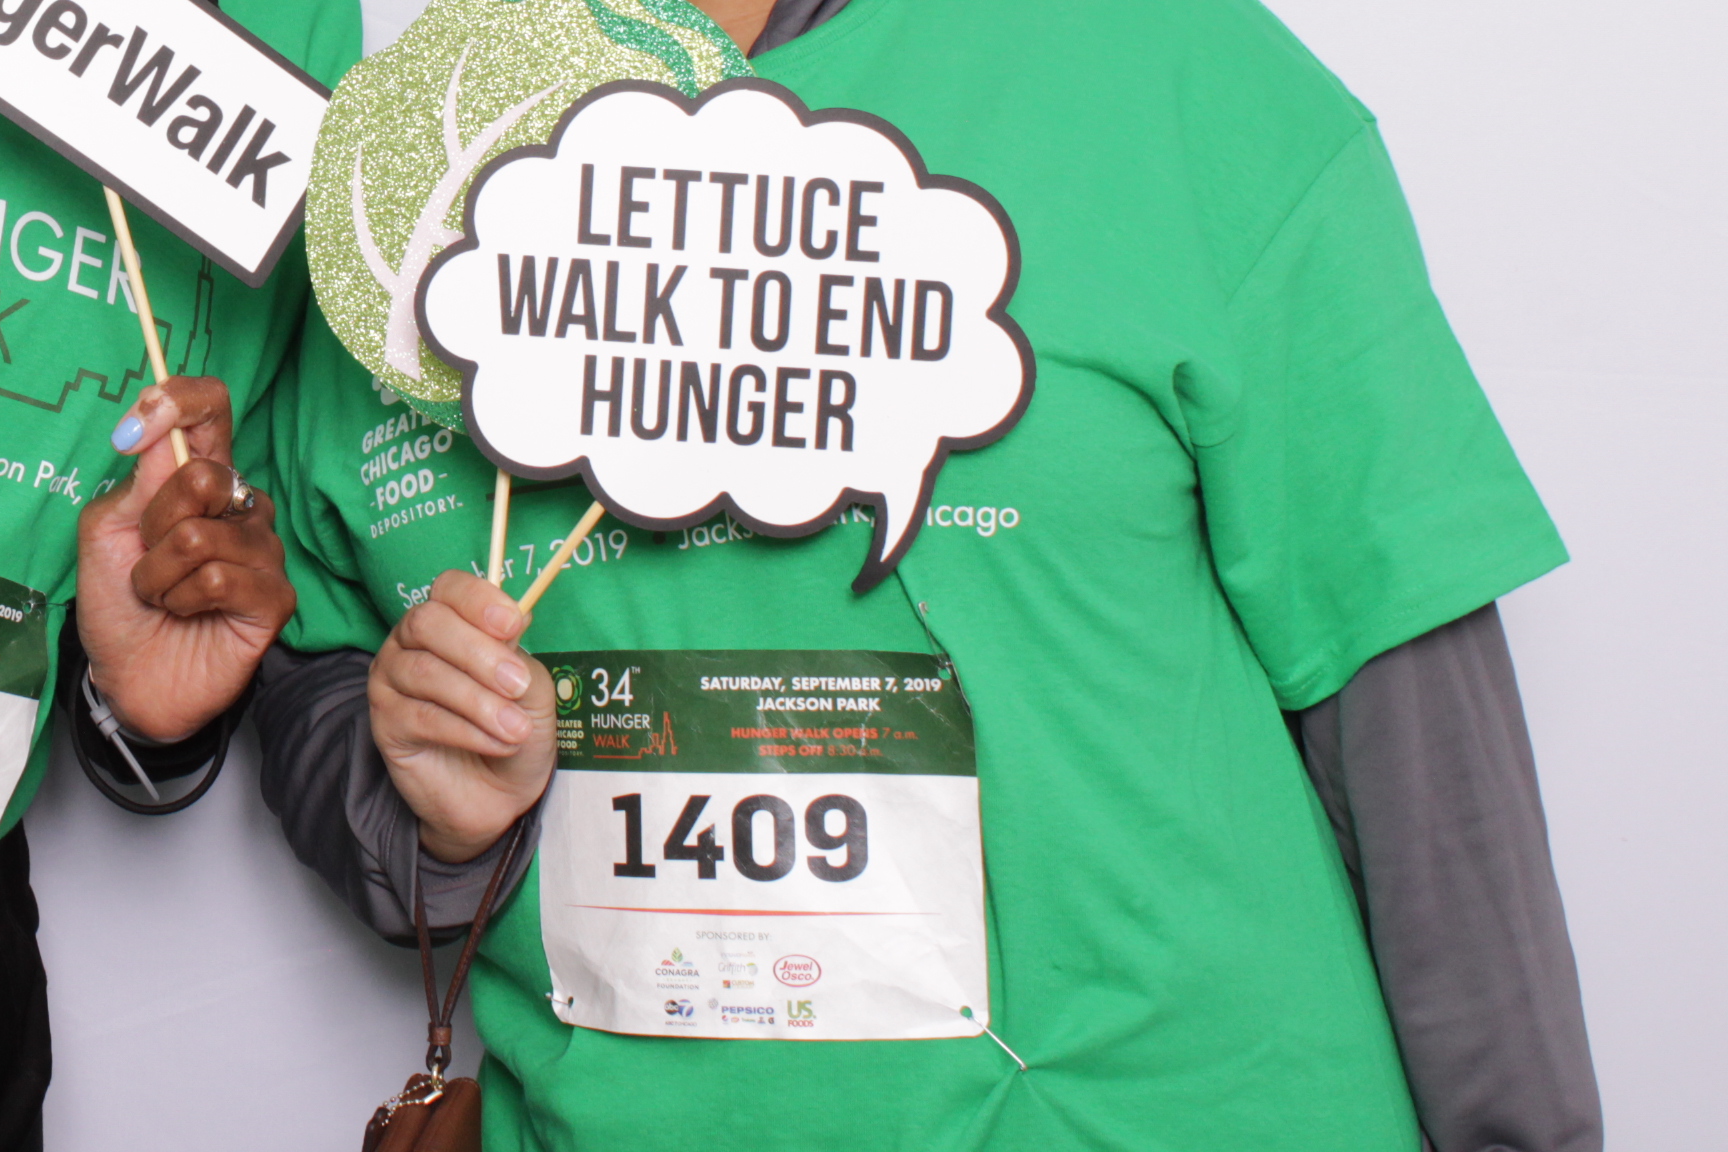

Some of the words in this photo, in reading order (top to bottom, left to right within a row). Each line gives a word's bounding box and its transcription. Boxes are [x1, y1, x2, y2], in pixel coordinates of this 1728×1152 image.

[576, 163, 885, 263] LETTUCE
[497, 252, 688, 347] WALK
[709, 267, 793, 353] TO
[814, 273, 954, 362] END
[580, 354, 858, 453] HUNGER
[362, 409, 432, 454] GREAT
[360, 429, 452, 486] CHICAGO
[33, 460, 82, 505] Park,
[370, 494, 456, 538] DEPOSITORY
[926, 504, 1020, 538] icago
[678, 510, 756, 550] Jack
[549, 529, 628, 569] 2019
[700, 676, 786, 693] SATURDAY,
[791, 676, 881, 691] SEPTEMBER
[885, 677, 898, 693] 7,
[903, 678, 942, 692] 2019
[756, 697, 834, 711] JACKSON
[836, 697, 881, 711] PARK
[556, 719, 583, 728] REATER
[591, 713, 651, 729] HUNGER
[556, 730, 585, 739] HICAGO
[593, 734, 631, 749] WALK
[731, 727, 788, 739] HUNGER
[790, 727, 831, 739] WALK
[832, 727, 879, 740] OPENS
[882, 728, 891, 739] 7
[758, 744, 796, 757] STEPS
[798, 744, 823, 757] OFF
[827, 745, 856, 757] 8:30
[612, 792, 869, 883] 1409
[696, 931, 756, 941] SPONSORED
[655, 967, 700, 977] CONAGRA
[779, 960, 813, 971] Jewel
[721, 1006, 775, 1015] PEPSICO
[787, 1019, 815, 1027] FOODS
